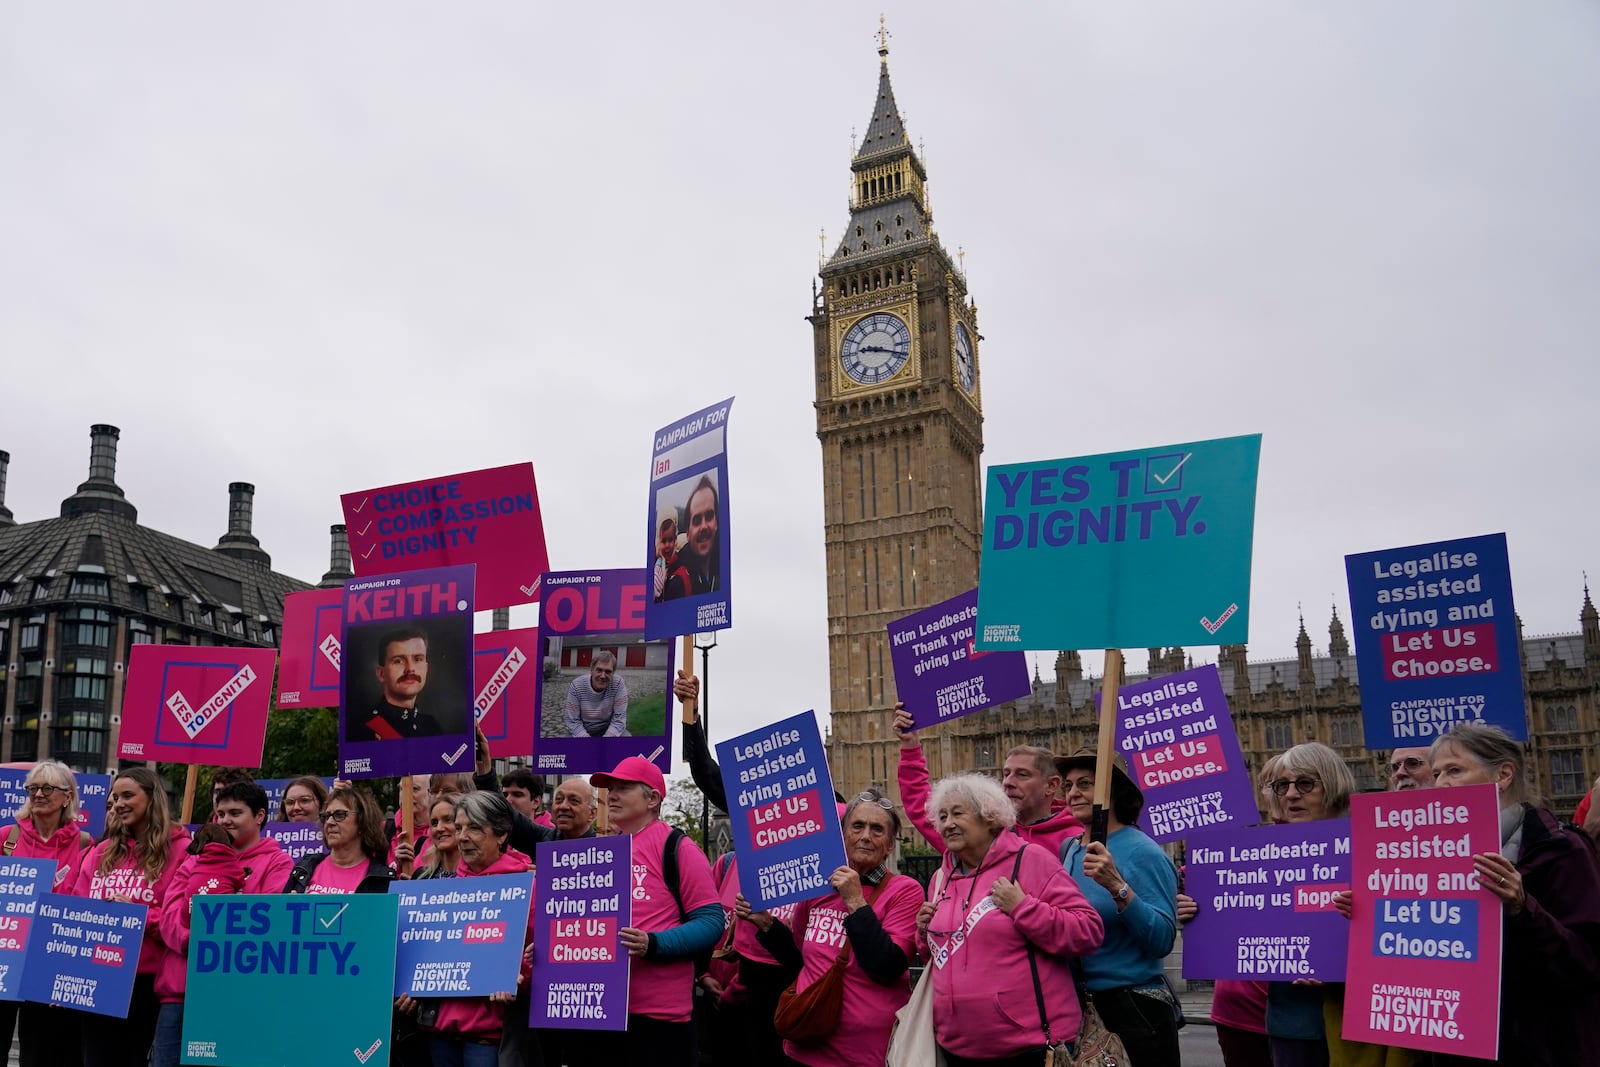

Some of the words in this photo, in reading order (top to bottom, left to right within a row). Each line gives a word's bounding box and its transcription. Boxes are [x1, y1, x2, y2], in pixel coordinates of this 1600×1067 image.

[655, 417, 702, 451] CAMPAIGN
[705, 407, 727, 428] FOR
[374, 480, 462, 513] CHOICE
[996, 465, 1091, 508] YES
[377, 492, 534, 536] COMPASSION
[993, 495, 1206, 551] DIGNITY.
[382, 525, 479, 560] DIGNITY
[1373, 551, 1478, 579] Legalise
[349, 580, 385, 592] CAMPAIGN
[386, 578, 401, 587] FOR
[546, 577, 584, 585] CAMPAIGN
[1376, 573, 1481, 604] assisted
[347, 581, 468, 624] KEITH.
[697, 608, 726, 621] DIGNITY
[697, 618, 705, 629] IN
[705, 613, 729, 627] DYING.
[893, 629, 916, 646] Kim
[919, 606, 978, 637] Leadbeate
[1370, 607, 1439, 633] dying
[1448, 598, 1495, 622] and
[912, 635, 949, 656] Thank
[951, 626, 973, 646] you
[984, 628, 1020, 636] DIGNITY
[1392, 631, 1434, 654] Let
[1442, 628, 1477, 649] Us
[914, 653, 949, 677] giving
[952, 647, 967, 661] us
[1391, 656, 1492, 678] Choose.
[477, 652, 521, 711] DIGNITY
[936, 680, 969, 696] CAMPAIGN
[970, 675, 984, 685] FOR
[936, 681, 985, 707] DIGNITY
[203, 669, 252, 720] DIGNITY
[938, 704, 951, 717] IN
[951, 692, 991, 714] DYING.
[1118, 680, 1199, 710] Legalise
[1391, 697, 1455, 710] CAMPAIGN
[1459, 695, 1485, 705] FOR
[171, 695, 193, 724] YES
[1124, 697, 1205, 729] assisted
[1391, 703, 1486, 724] DIGNITY
[1121, 728, 1176, 751] dying
[1181, 715, 1218, 737] and
[1392, 723, 1415, 738] IN
[734, 728, 800, 762] Legalise
[1141, 746, 1175, 767] Let
[1180, 741, 1208, 757] Us
[740, 747, 806, 784] assisted
[1143, 761, 1223, 787] Choose.
[83, 784, 106, 795] MP:
[738, 782, 782, 807] dying
[786, 767, 817, 792] and
[753, 801, 782, 825] Let
[785, 796, 809, 815] Us
[1148, 796, 1199, 814] CAMPAIGN
[1201, 791, 1222, 803] FOR
[1149, 798, 1223, 825] DIGNITY
[1152, 822, 1172, 836] IN
[1172, 809, 1234, 832] DYING.
[1374, 801, 1469, 832] Legalise
[755, 819, 821, 847] Choose.
[552, 847, 614, 870] Legalise
[1192, 847, 1224, 865] Kim
[1230, 840, 1328, 863] Leadbeater
[1375, 834, 1470, 860] assisted
[758, 858, 801, 876] CAMPAIGN
[803, 853, 820, 865] FOR
[759, 860, 820, 890] DIGNITY
[1215, 867, 1268, 886] Thank
[1274, 868, 1306, 887] you
[1312, 863, 1339, 881] for
[552, 870, 614, 891] assisted
[761, 886, 777, 901] IN
[778, 874, 829, 897] DYING.
[1367, 868, 1429, 896] dying
[6, 901, 37, 914] and
[398, 893, 417, 906] im
[421, 890, 496, 906] Leadbeater
[500, 888, 527, 901] MP:
[546, 896, 587, 918] dying
[591, 894, 619, 912] and
[1213, 891, 1265, 912] giving
[1271, 892, 1291, 907] us
[39, 904, 61, 919] Kim
[63, 907, 120, 927] Leadbeater
[122, 916, 142, 930] MP:
[200, 902, 272, 936] YES
[407, 910, 447, 924] Thank
[452, 910, 477, 924] you
[481, 907, 501, 920] for
[808, 907, 850, 919] CAMPAIG
[1383, 900, 1421, 923] Let
[1429, 901, 1461, 925] Us
[52, 922, 82, 939] Thank
[86, 931, 105, 944] you
[107, 931, 123, 945] for
[402, 928, 442, 944] giving
[446, 929, 463, 940] us
[466, 926, 503, 942] hope.
[556, 920, 581, 938] Let
[586, 919, 606, 937] Us
[1238, 936, 1288, 946] CAMPAIGN
[1291, 936, 1311, 945] FOR
[46, 939, 78, 957] giving
[81, 946, 93, 957] us
[95, 947, 123, 963] hope.
[196, 940, 361, 977] DIGNITY.
[553, 944, 613, 961] Choose.
[1237, 945, 1310, 960] DIGNITY
[1379, 932, 1472, 960] Choose.
[413, 968, 471, 981] DIGNITY
[416, 962, 455, 970] CAMPAIGN
[456, 961, 471, 969] FOR
[1237, 960, 1254, 974] IN
[1256, 960, 1315, 975] DYING.
[53, 980, 97, 996] DIGNITY
[55, 974, 85, 984] CAMPAIGN
[86, 979, 98, 987] FOR
[411, 980, 426, 991] IN
[427, 980, 471, 992] DYING.
[548, 983, 587, 991] CAMPAIGN
[589, 983, 605, 991] FOR
[1372, 983, 1432, 999] CAMPAIGN
[1435, 988, 1461, 1001] FOR
[51, 990, 63, 1001] IN
[63, 992, 96, 1008] DYING.
[547, 991, 605, 1006] DIGNITY
[1370, 994, 1460, 1020] DIGNITY
[546, 1005, 561, 1019] IN
[562, 1005, 607, 1020] DYING.
[1369, 1012, 1390, 1031] IN
[1393, 1014, 1465, 1041] DYING.
